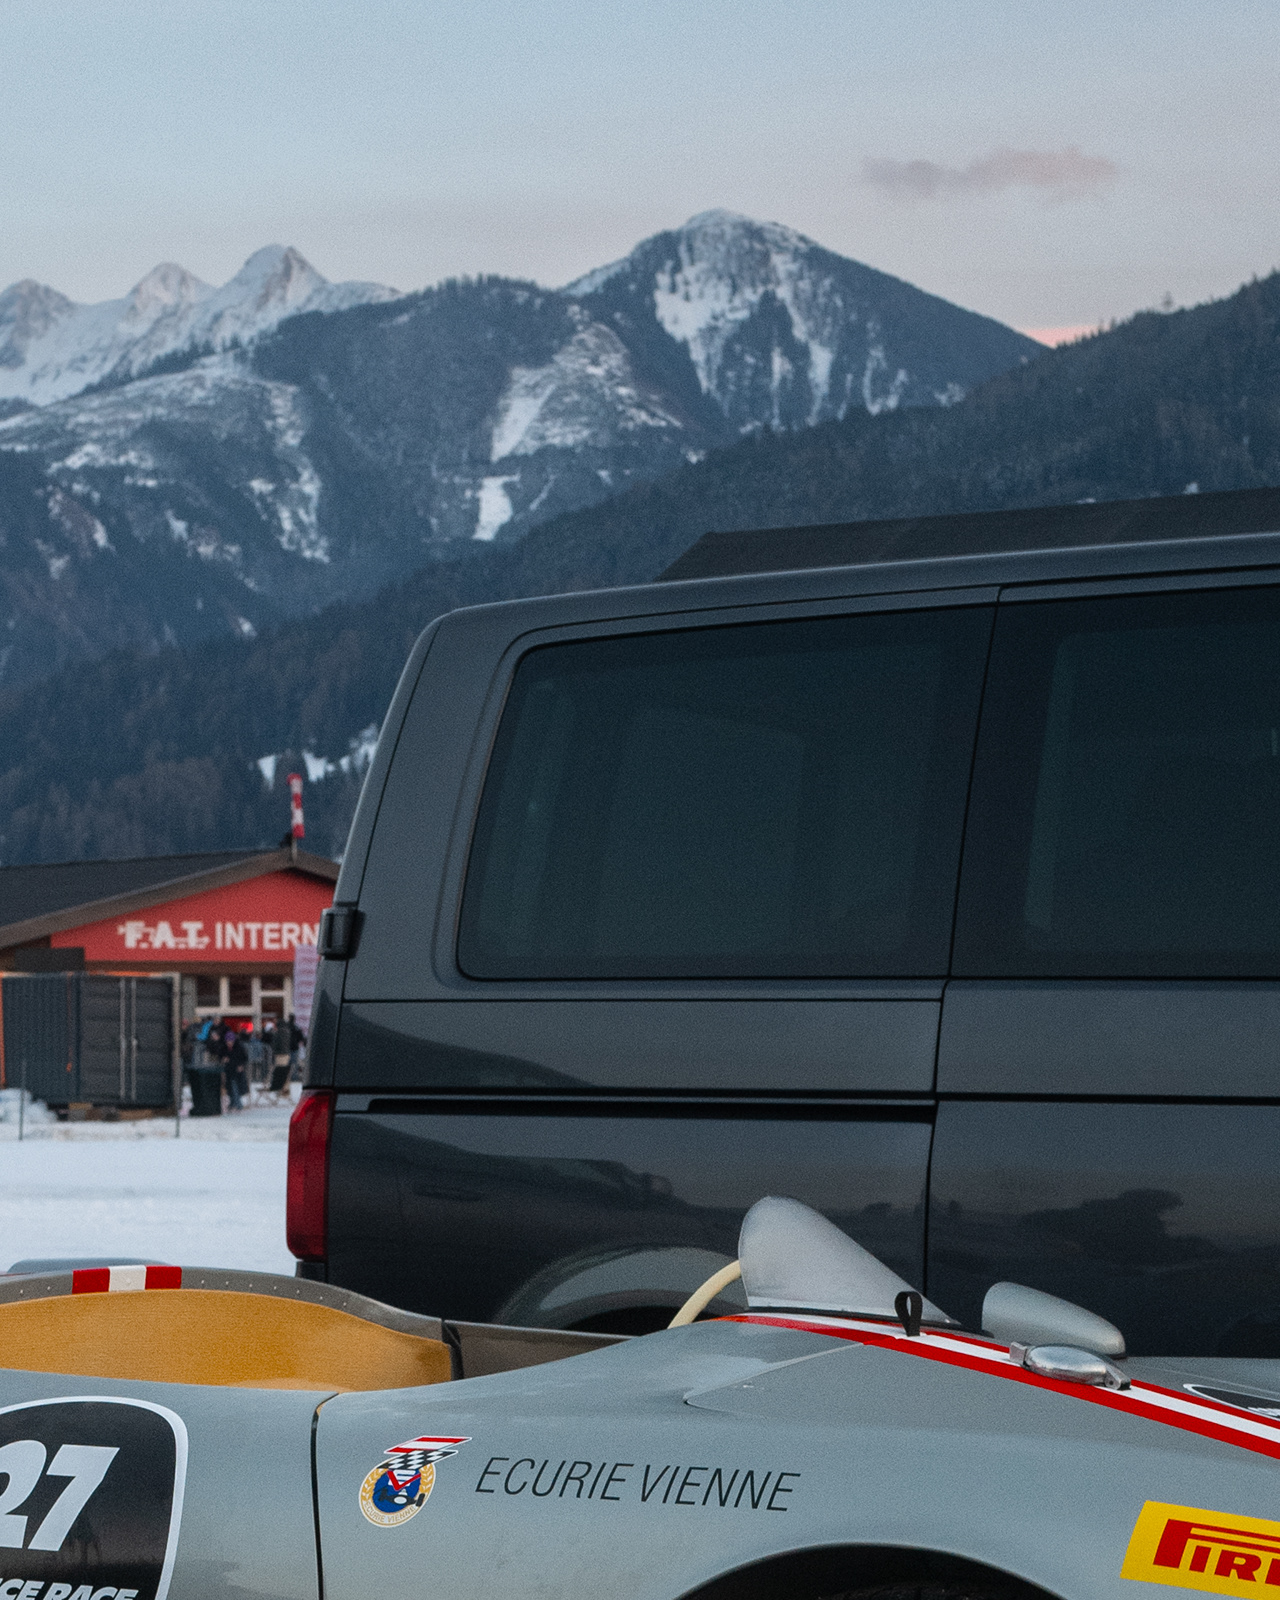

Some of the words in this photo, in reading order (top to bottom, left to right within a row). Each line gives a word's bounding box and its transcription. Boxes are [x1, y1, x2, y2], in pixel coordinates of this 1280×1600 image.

[475, 1457, 634, 1502] ECURIE
[641, 1464, 801, 1511] VIENNE
[364, 1501, 386, 1522] ECURIE
